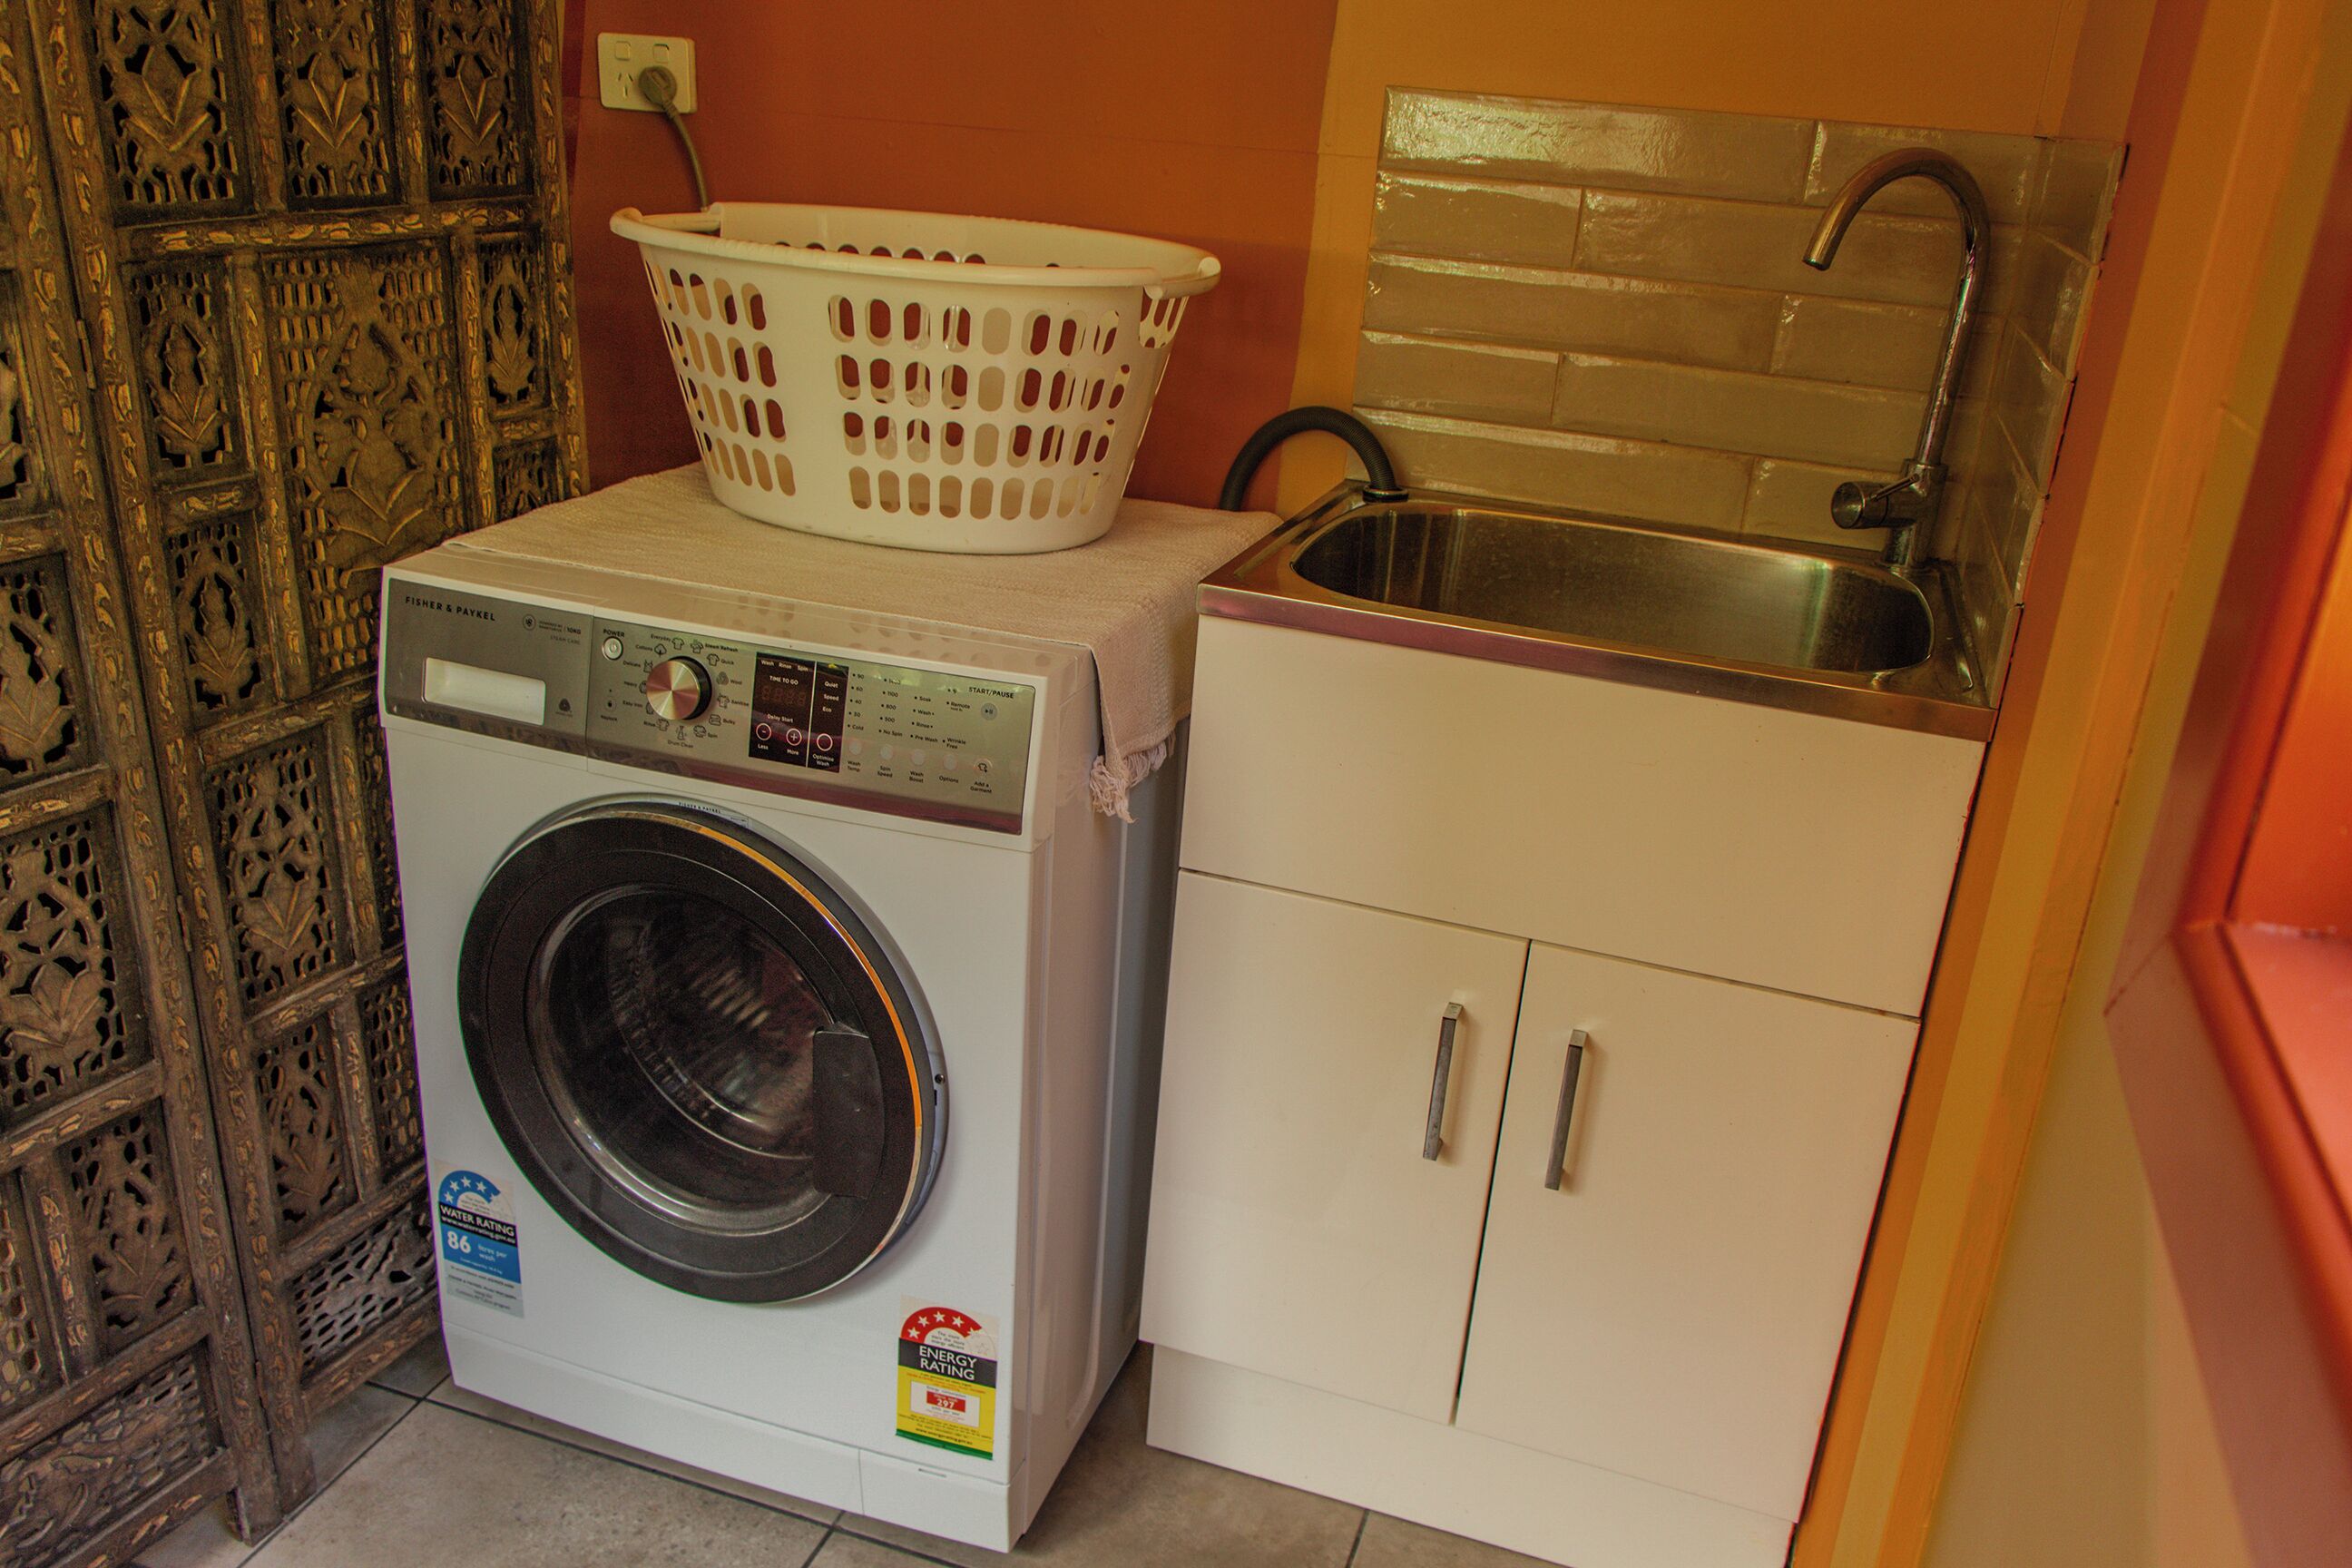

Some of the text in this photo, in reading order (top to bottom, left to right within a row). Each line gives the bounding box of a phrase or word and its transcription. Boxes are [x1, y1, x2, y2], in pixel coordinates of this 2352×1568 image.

[406, 596, 495, 621] FISHER & PAYKEL
[603, 629, 624, 637] POWER
[651, 633, 671, 642] Everyday
[798, 664, 808, 672] Spin
[769, 675, 781, 683] TIME
[824, 681, 838, 689] Quiet
[823, 693, 839, 701] Speed
[969, 687, 1014, 699] START/PAUSE
[951, 701, 971, 710] Remote
[767, 713, 794, 723] Delay Start
[946, 737, 966, 745] Wrinkle
[812, 753, 835, 762] Optimise
[938, 775, 959, 783] Options
[970, 786, 992, 794] Garment
[440, 1204, 475, 1225] WATER
[476, 1216, 514, 1237] RATING
[447, 1230, 471, 1254] 86
[479, 1253, 495, 1262] wash
[495, 1249, 508, 1259] per
[919, 1346, 977, 1369] ENERGY
[920, 1358, 975, 1381] RATING
[936, 1398, 956, 1409] 297
